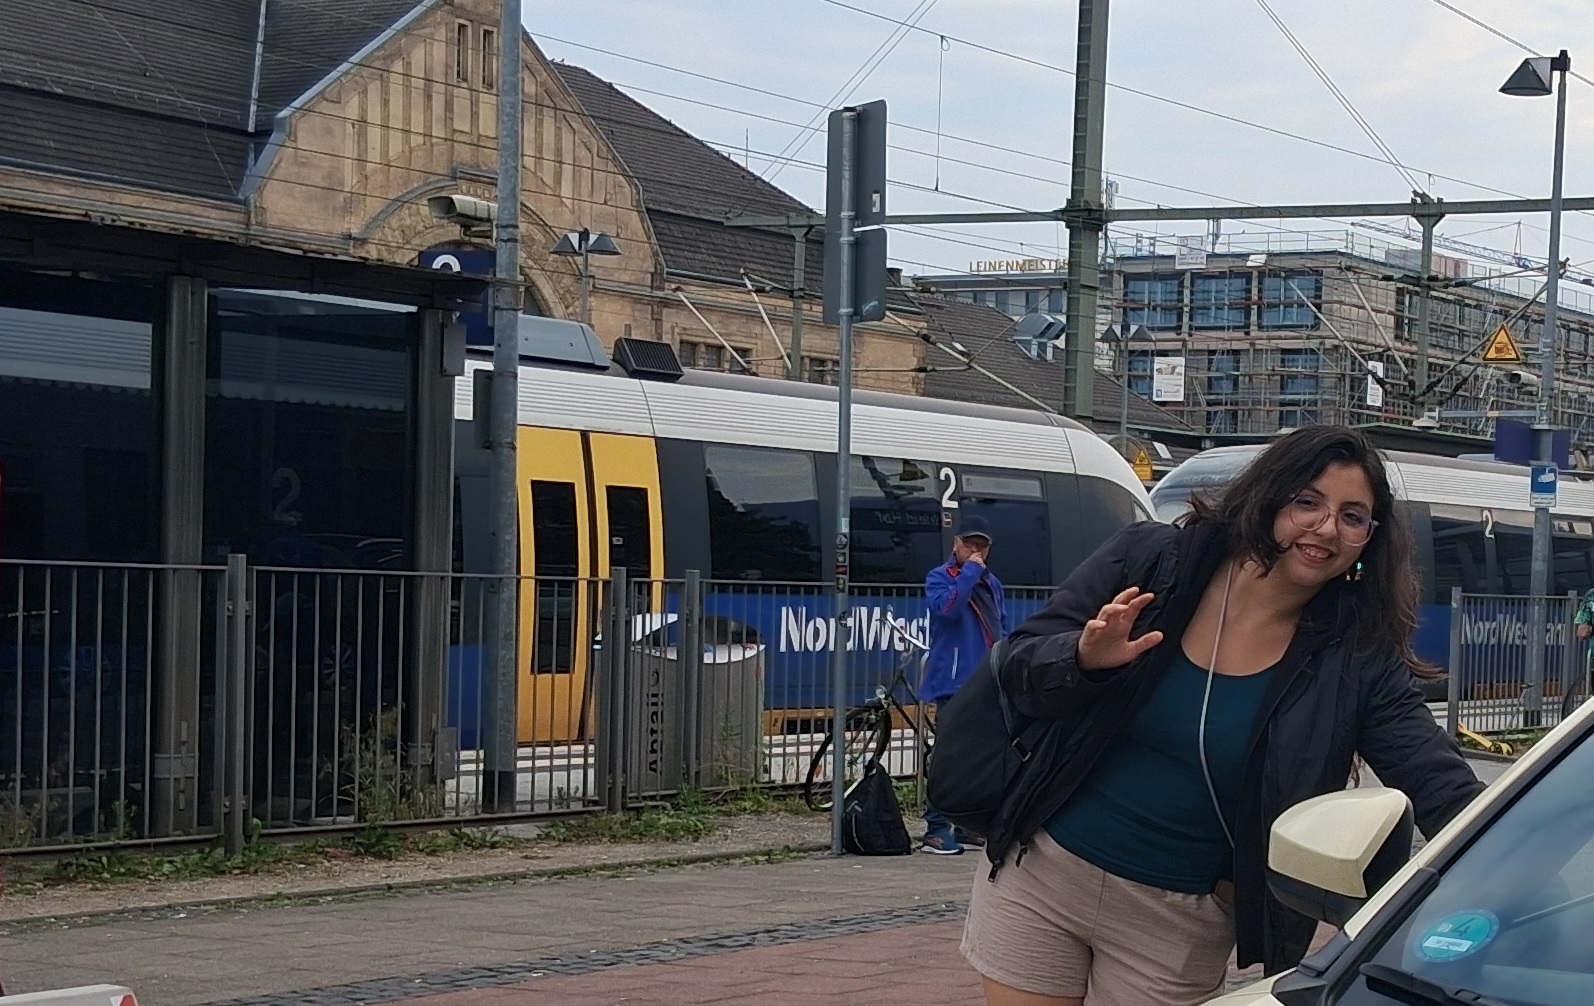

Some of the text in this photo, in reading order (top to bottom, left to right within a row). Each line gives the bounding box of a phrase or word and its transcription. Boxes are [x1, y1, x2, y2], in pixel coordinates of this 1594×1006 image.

[940, 466, 959, 509] 2
[1482, 510, 1495, 539] 2
[1451, 917, 1476, 937] 4
